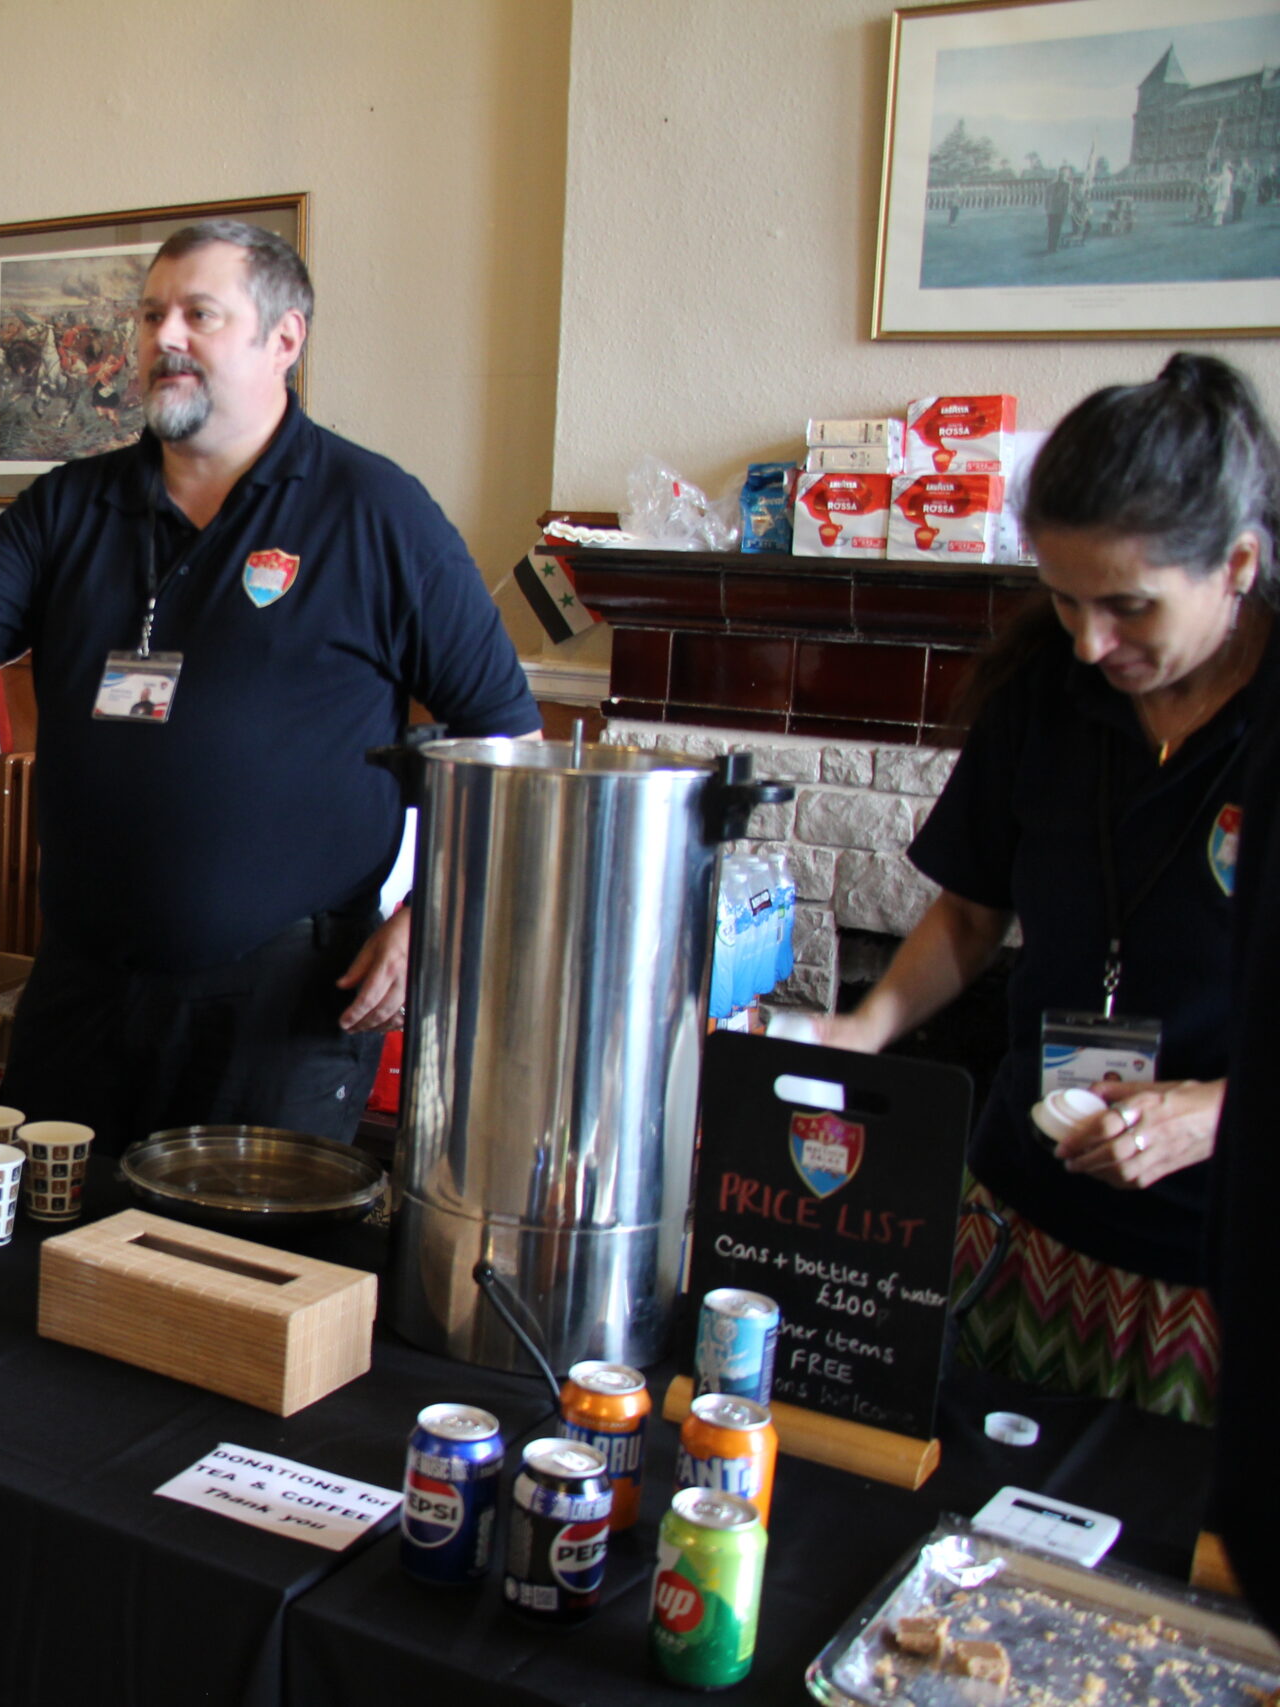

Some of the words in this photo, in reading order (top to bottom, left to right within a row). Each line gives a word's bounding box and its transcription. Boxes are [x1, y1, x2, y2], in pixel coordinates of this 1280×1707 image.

[939, 427, 970, 437] ROSSA
[827, 501, 857, 511] ROSSA
[923, 504, 954, 513] ROSSA
[720, 1171, 821, 1229] PRICE
[836, 1204, 927, 1249] LIST
[714, 1234, 770, 1264] Cans
[773, 1253, 788, 1269] +
[795, 1253, 869, 1288] bottles
[877, 1272, 899, 1299] of
[900, 1286, 949, 1307] water
[779, 1317, 818, 1340] her
[790, 1349, 853, 1384] FREE
[195, 1464, 236, 1482] TEA
[250, 1481, 265, 1491] &
[281, 1490, 374, 1522] COFFEE
[212, 1450, 348, 1494] DONATIONS
[358, 1492, 392, 1507] for
[204, 1486, 272, 1514] Thank
[279, 1513, 328, 1530] you
[408, 1493, 458, 1521] EPSI
